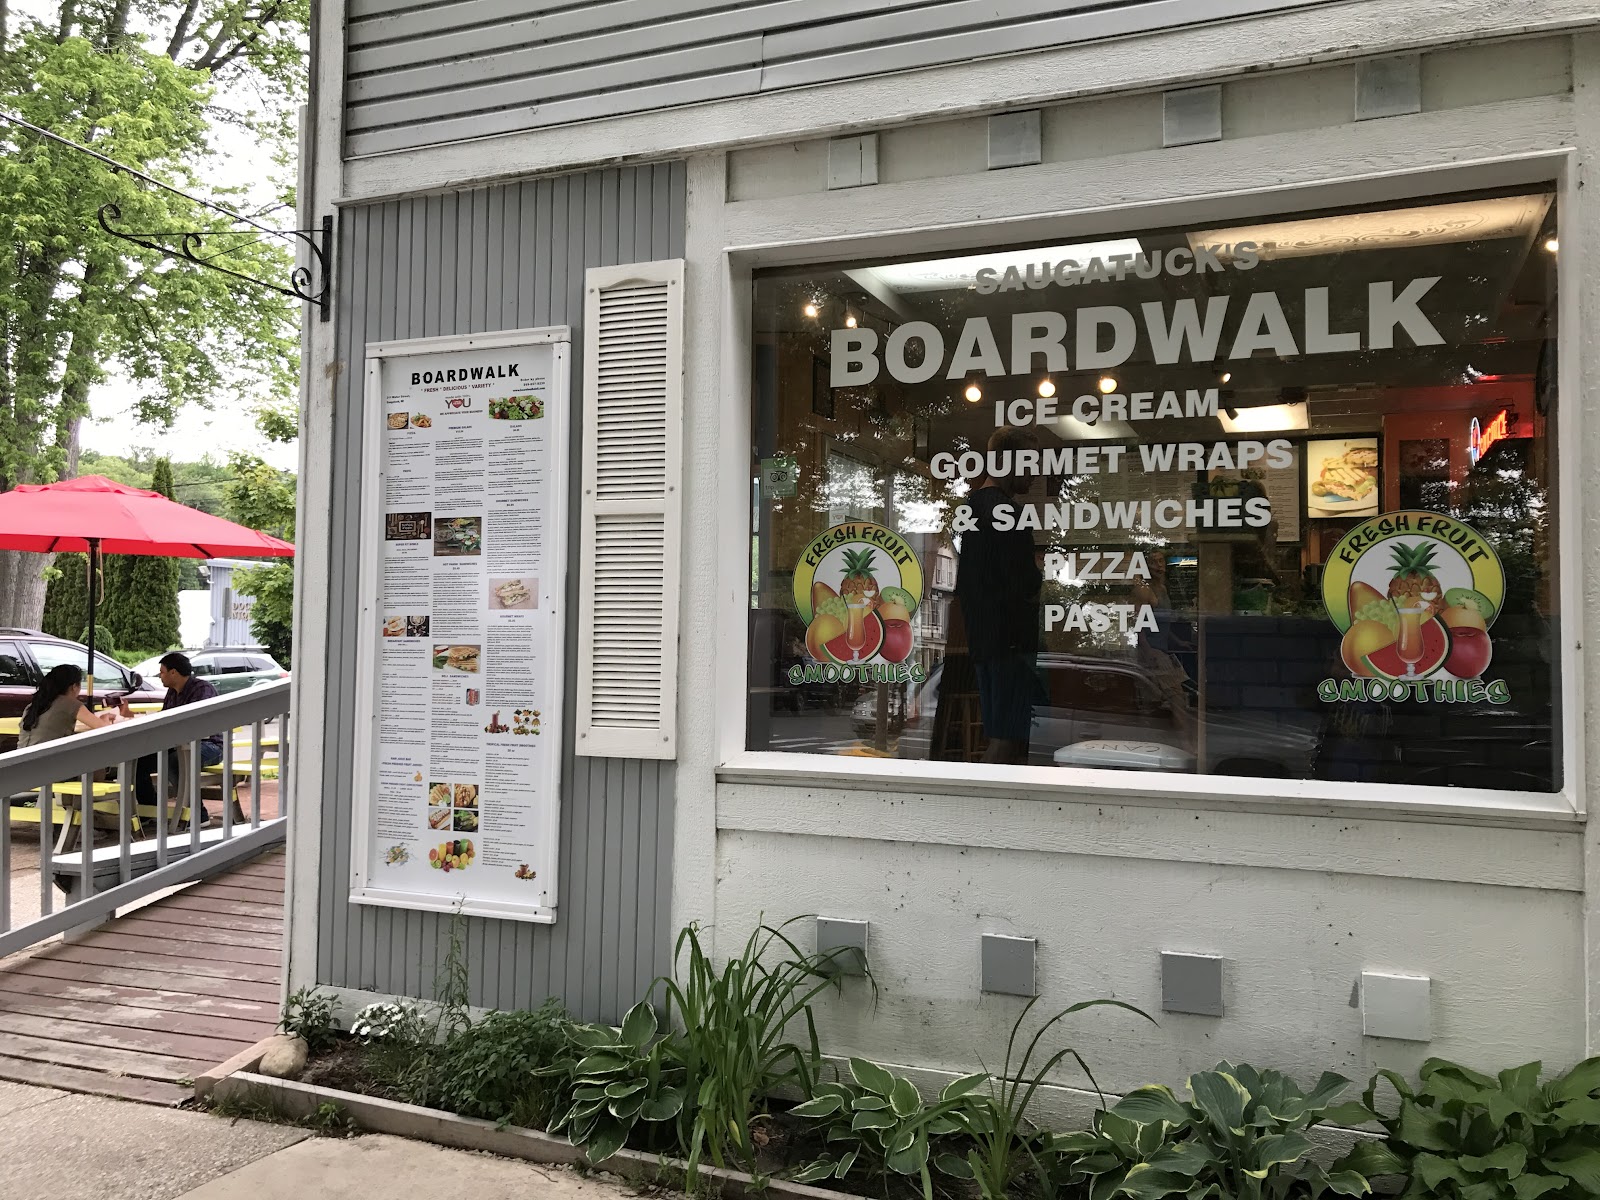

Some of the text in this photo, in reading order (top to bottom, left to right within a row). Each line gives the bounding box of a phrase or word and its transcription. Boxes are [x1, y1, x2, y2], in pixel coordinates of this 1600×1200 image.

[975, 241, 1260, 295] SAUGATUCK'S
[829, 276, 1447, 388] BOARDWALK
[411, 363, 520, 385] BOARDWALK
[994, 388, 1219, 427] ICE CREAM
[930, 438, 1293, 479] GOURMET WRAPS
[952, 503, 980, 532] &
[991, 497, 1272, 532] SANDWICHES
[805, 525, 914, 568] FRESH FRUIT
[1339, 515, 1490, 564] FRESH FRUIT
[1044, 551, 1151, 581] PIZZA
[1044, 603, 1160, 633] PASTA
[788, 662, 927, 685] SMOOTHIES
[1317, 678, 1511, 705] SMOOTHIES
